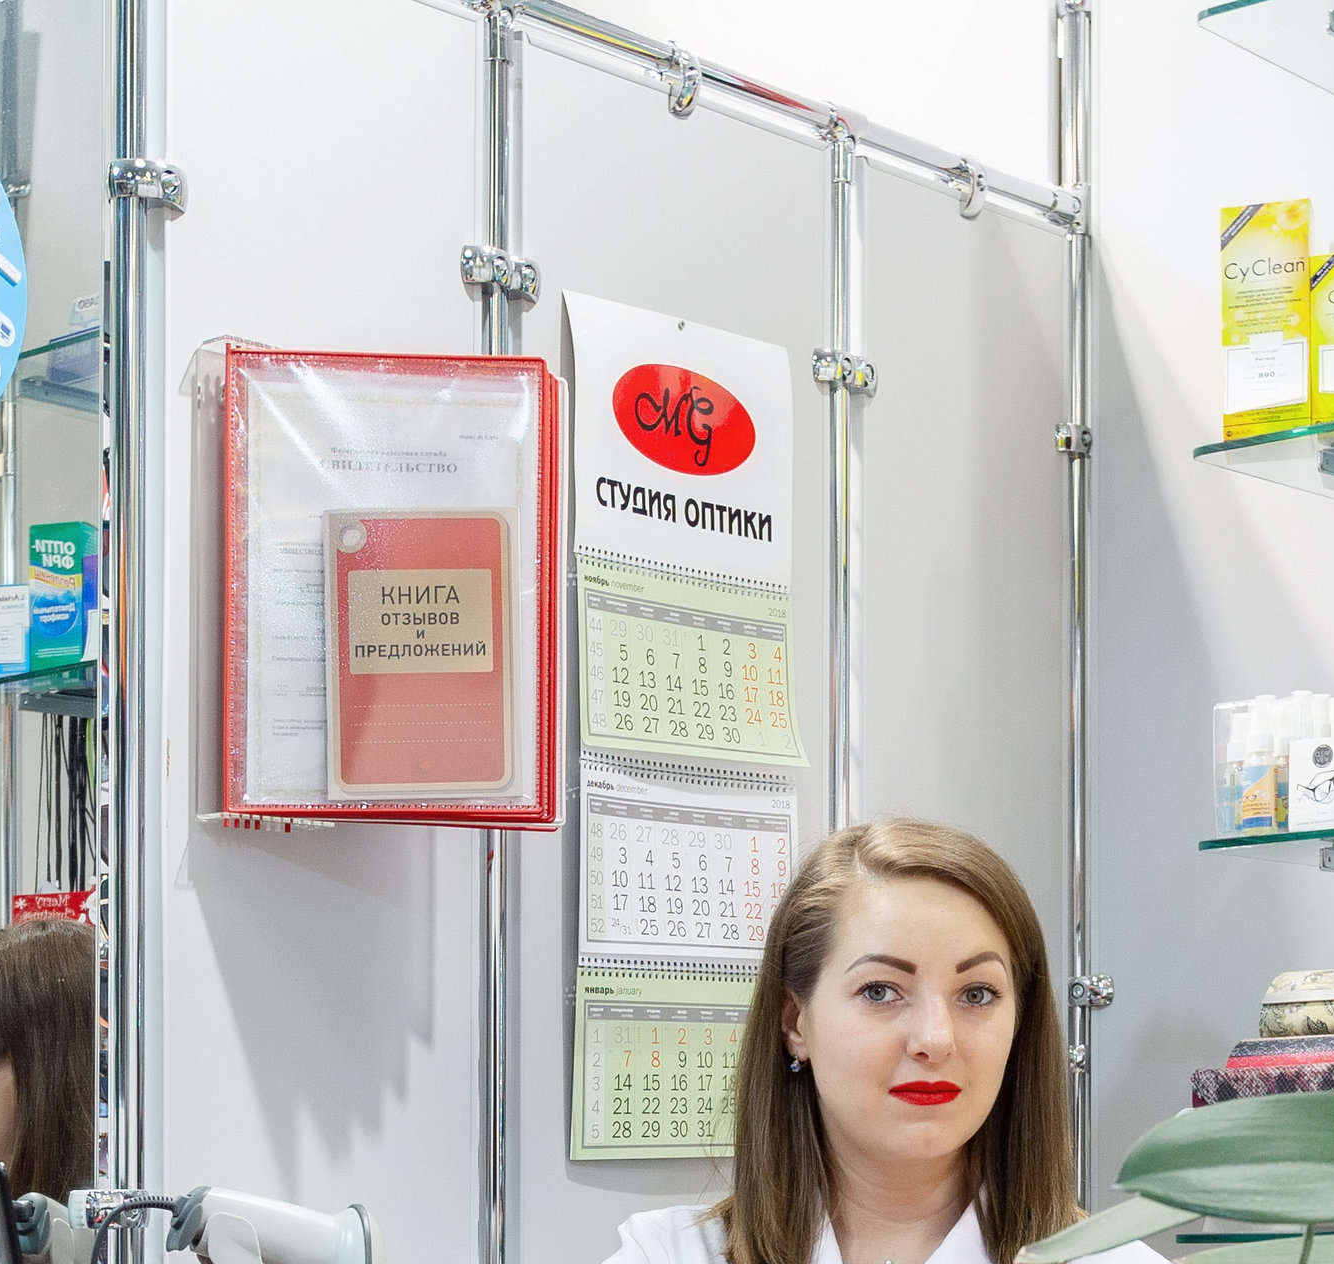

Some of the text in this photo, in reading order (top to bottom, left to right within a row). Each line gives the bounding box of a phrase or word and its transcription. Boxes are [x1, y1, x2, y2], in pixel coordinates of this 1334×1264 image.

[1224, 257, 1306, 283] CyClean
[596, 477, 772, 543] СТУДИЯ ОПТИКИ
[584, 575, 645, 592] ноябрь november
[381, 585, 460, 605] КНИГА
[381, 612, 459, 626] ОТЗЫВОВ
[768, 608, 787, 618] 2018
[355, 641, 486, 659] ПРЕДЛОЖЕНИЙ
[698, 635, 782, 662] 1 2 3 4
[619, 644, 783, 685] 5 6 7 8 9 10 11
[612, 667, 785, 707] 12 13 14 15 16 17 18
[614, 690, 787, 729] 19 20 21 22 23 24 25
[615, 713, 740, 744] 26 27 28 29 30
[587, 780, 648, 795] декабрь december
[772, 799, 790, 809] 2018
[584, 986, 643, 997] январь january
